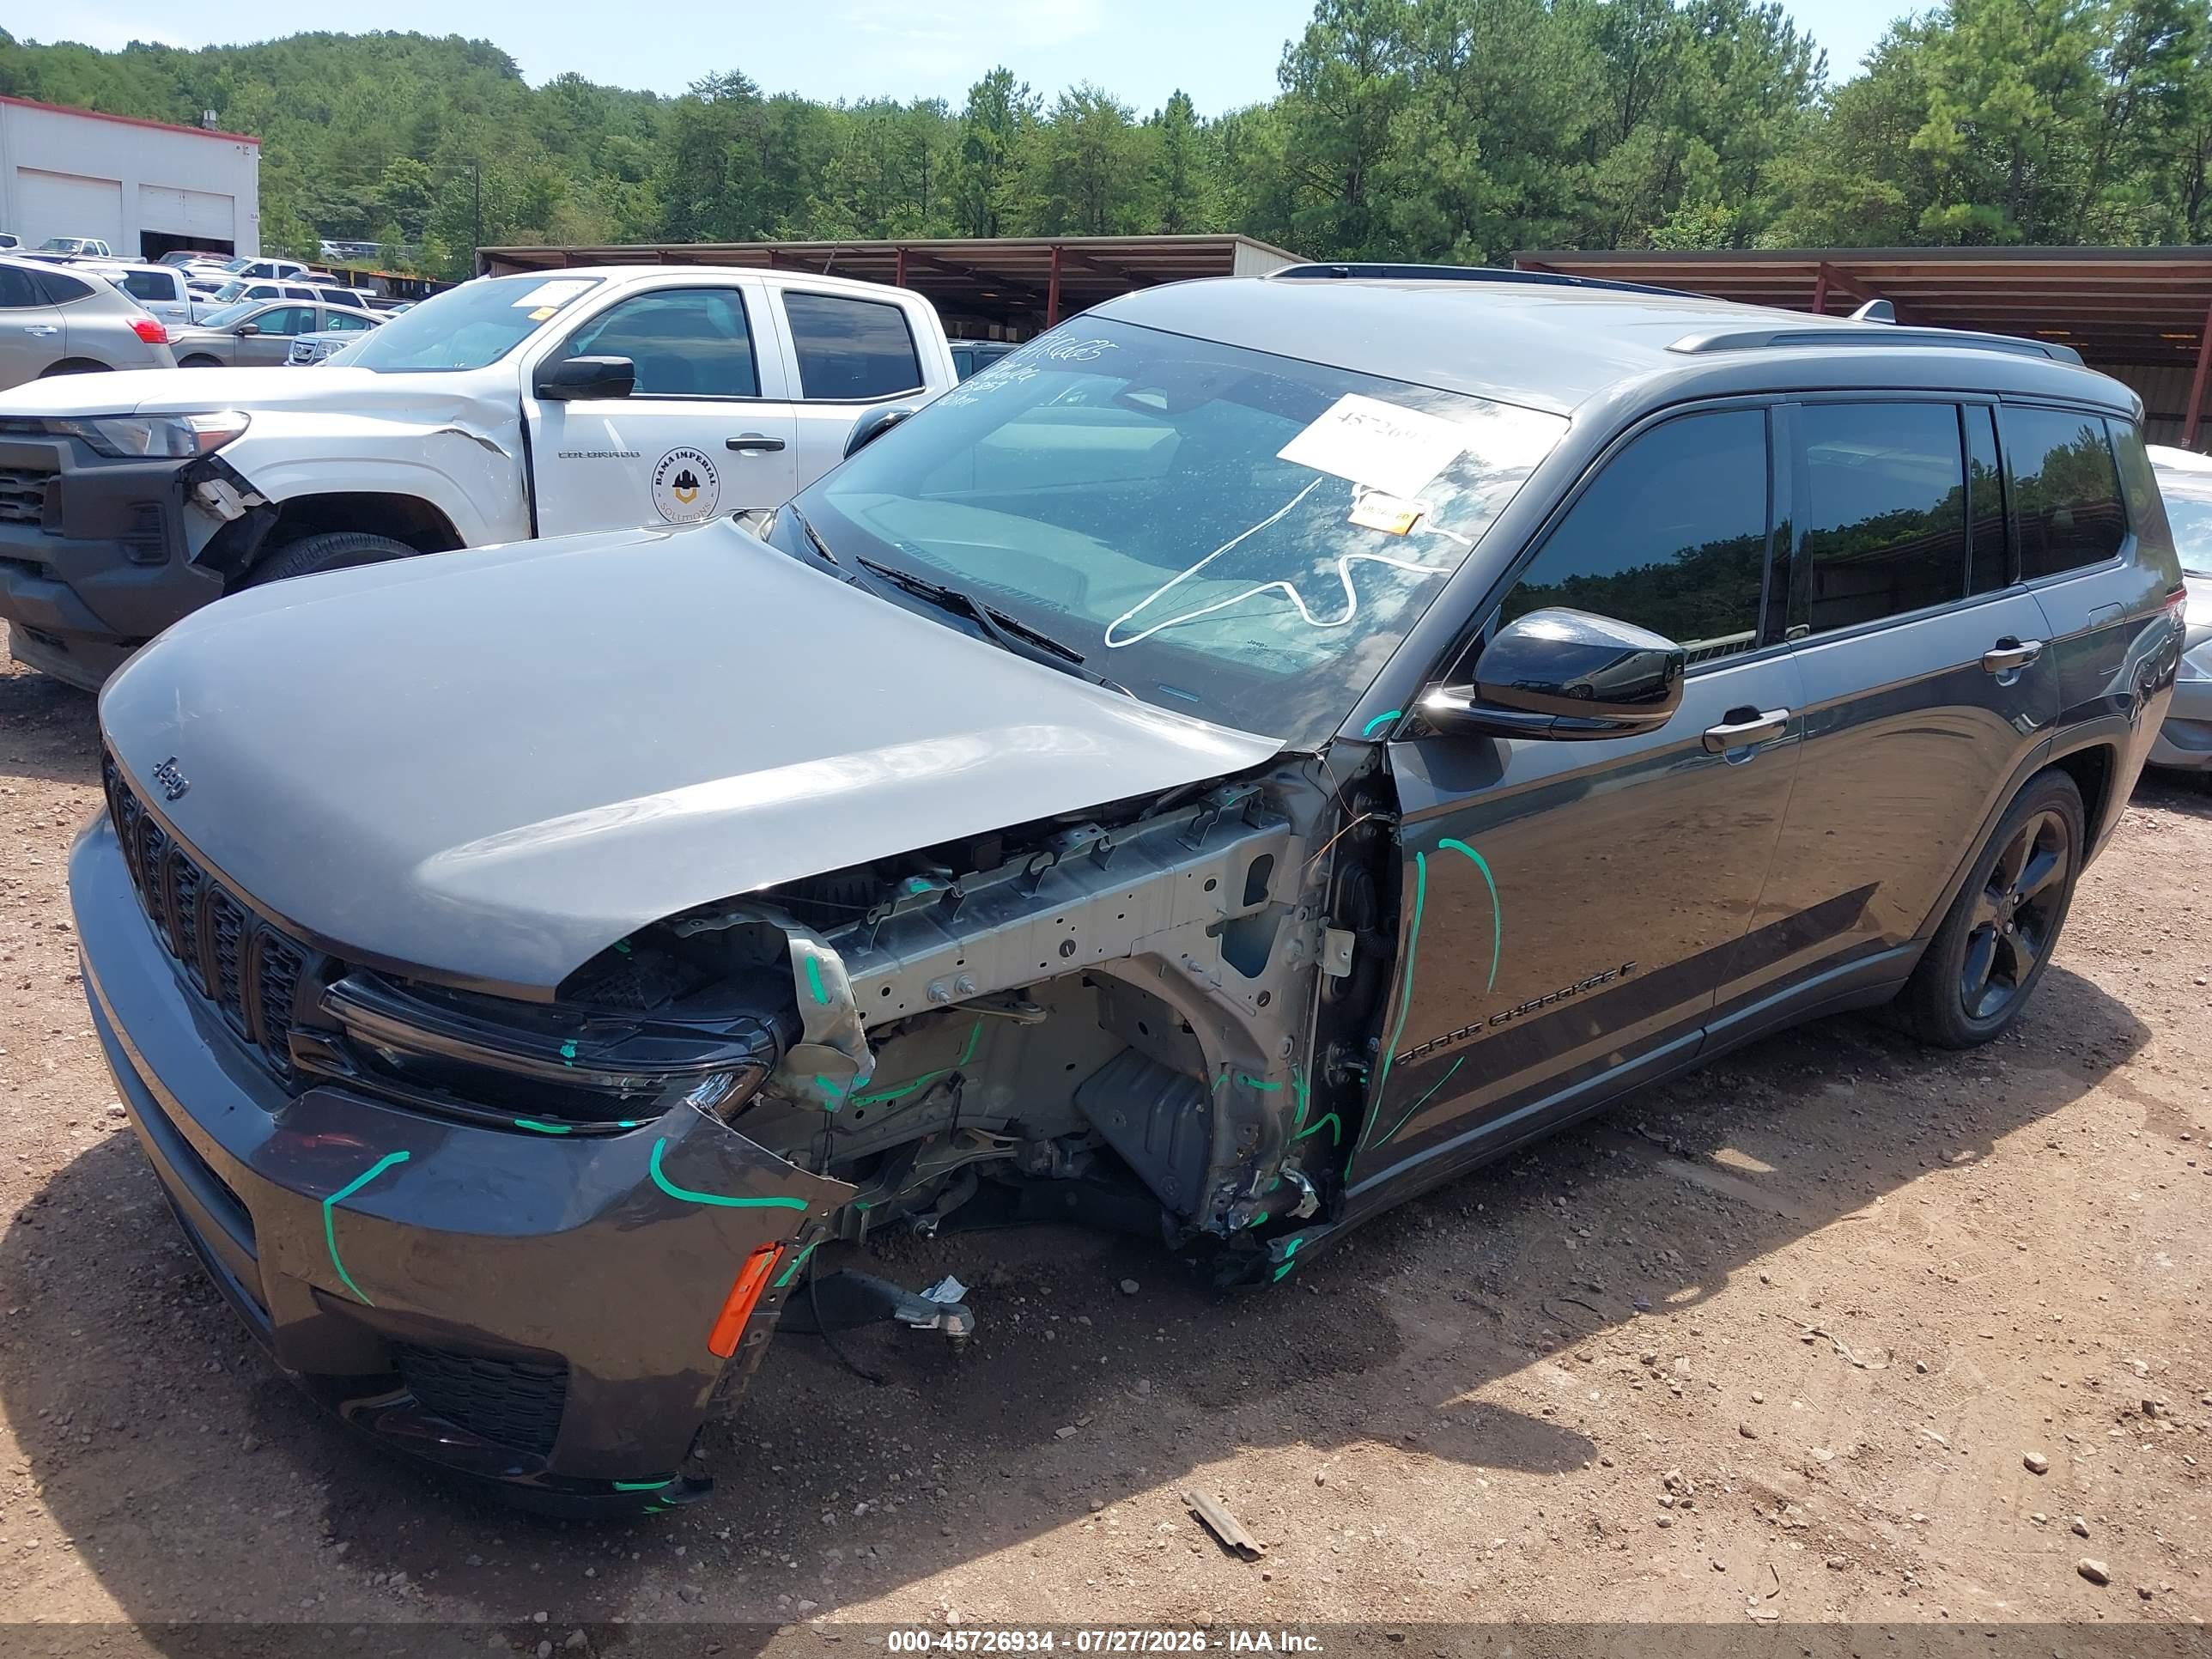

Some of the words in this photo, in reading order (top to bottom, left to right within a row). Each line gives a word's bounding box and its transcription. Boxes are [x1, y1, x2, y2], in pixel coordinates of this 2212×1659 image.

[655, 456, 676, 486] BAMA
[675, 451, 716, 487] IMPERIAL
[152, 755, 190, 801] Jeep
[1393, 1022, 1483, 1066] GRAND
[1488, 969, 1618, 1027] CHEROKEE
